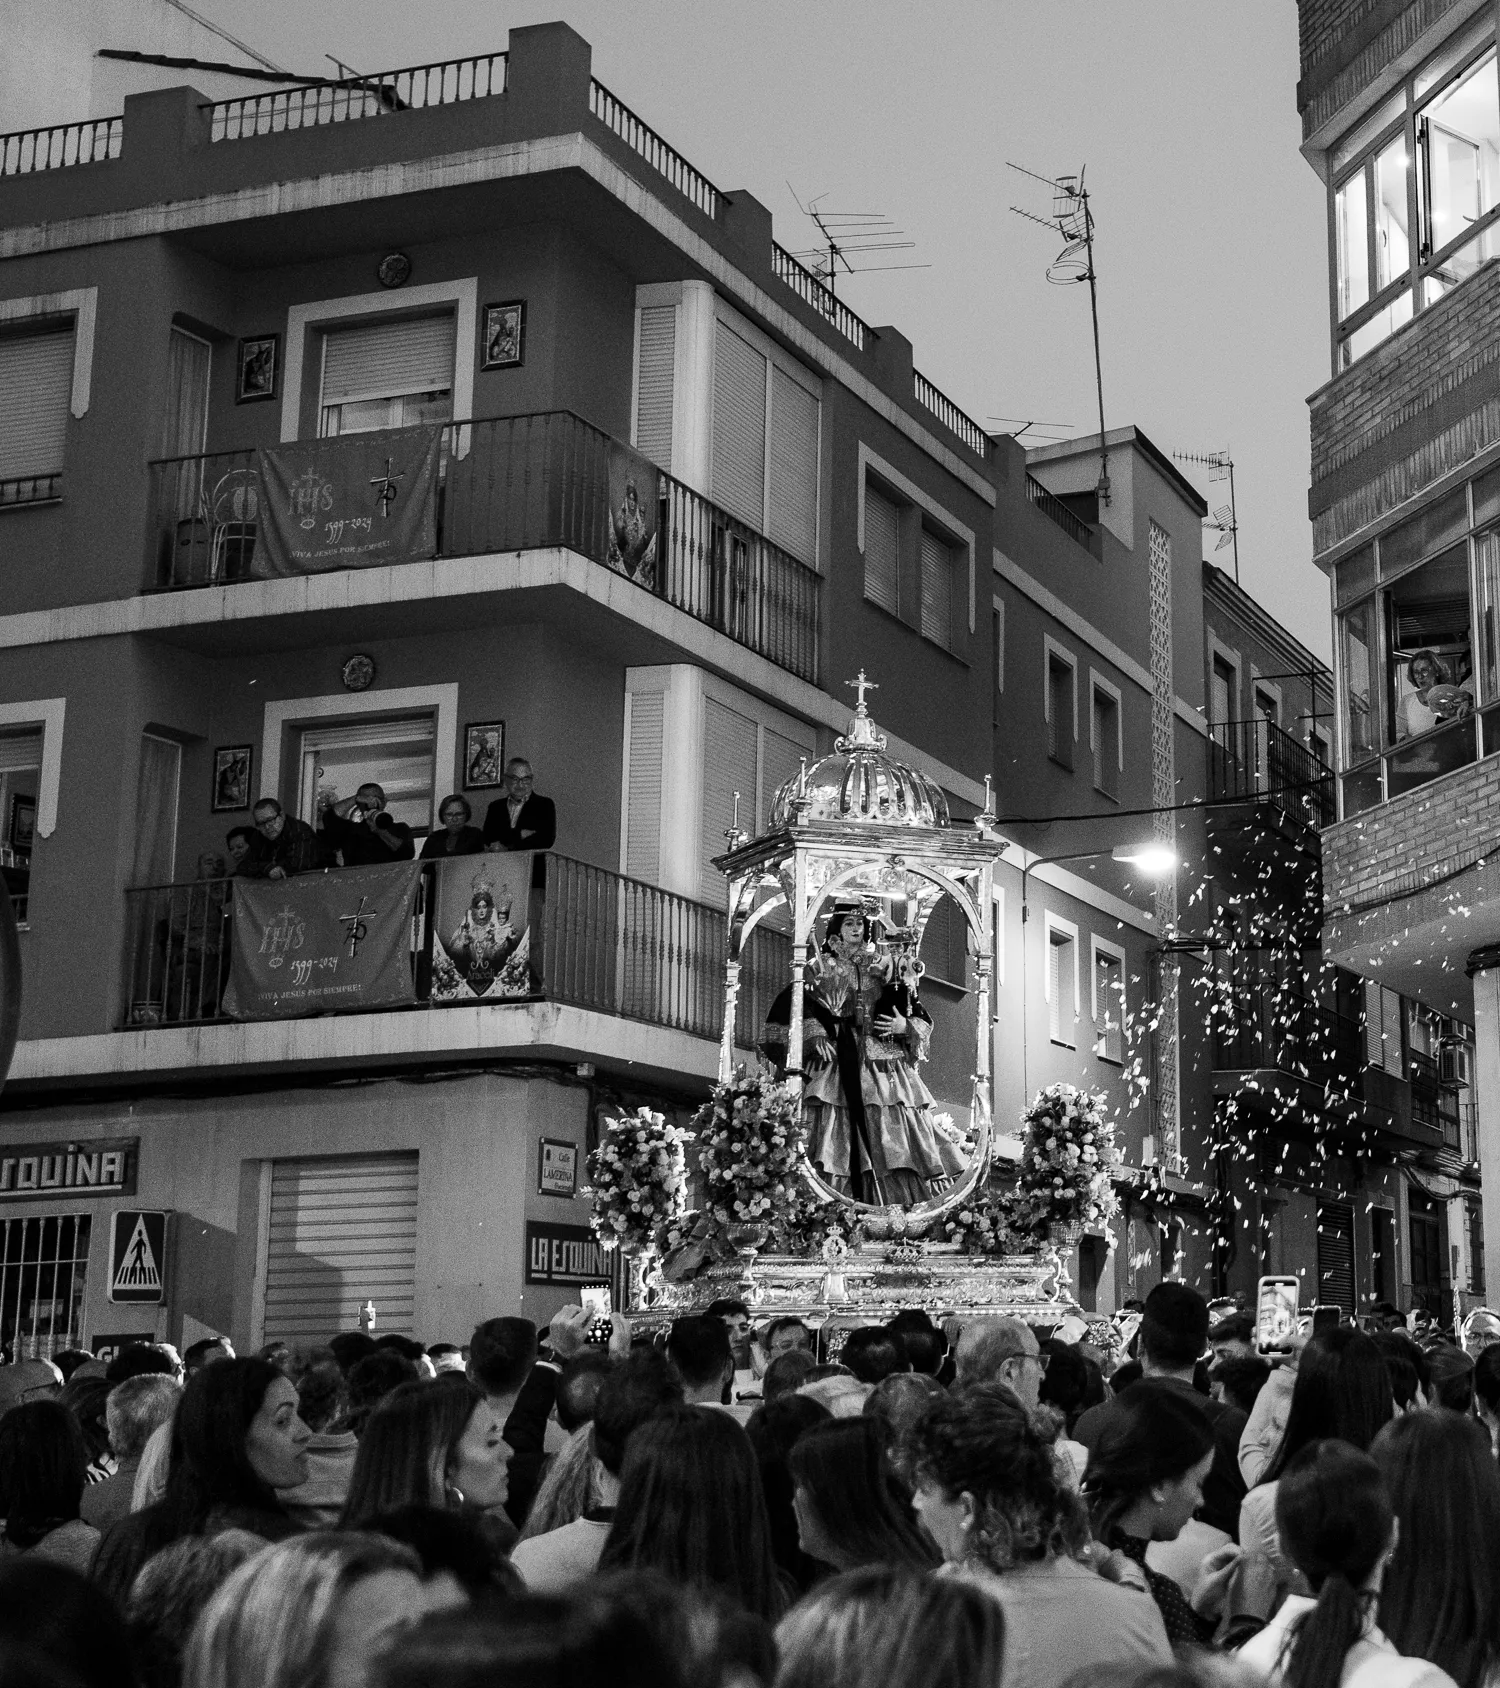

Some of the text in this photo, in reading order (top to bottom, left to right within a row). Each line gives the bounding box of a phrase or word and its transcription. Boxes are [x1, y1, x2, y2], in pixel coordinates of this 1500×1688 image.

[324, 517, 372, 544] 1599-2024
[290, 957, 339, 985] 1599-2024
[308, 987, 322, 996] POR
[531, 1237, 549, 1271] LA
